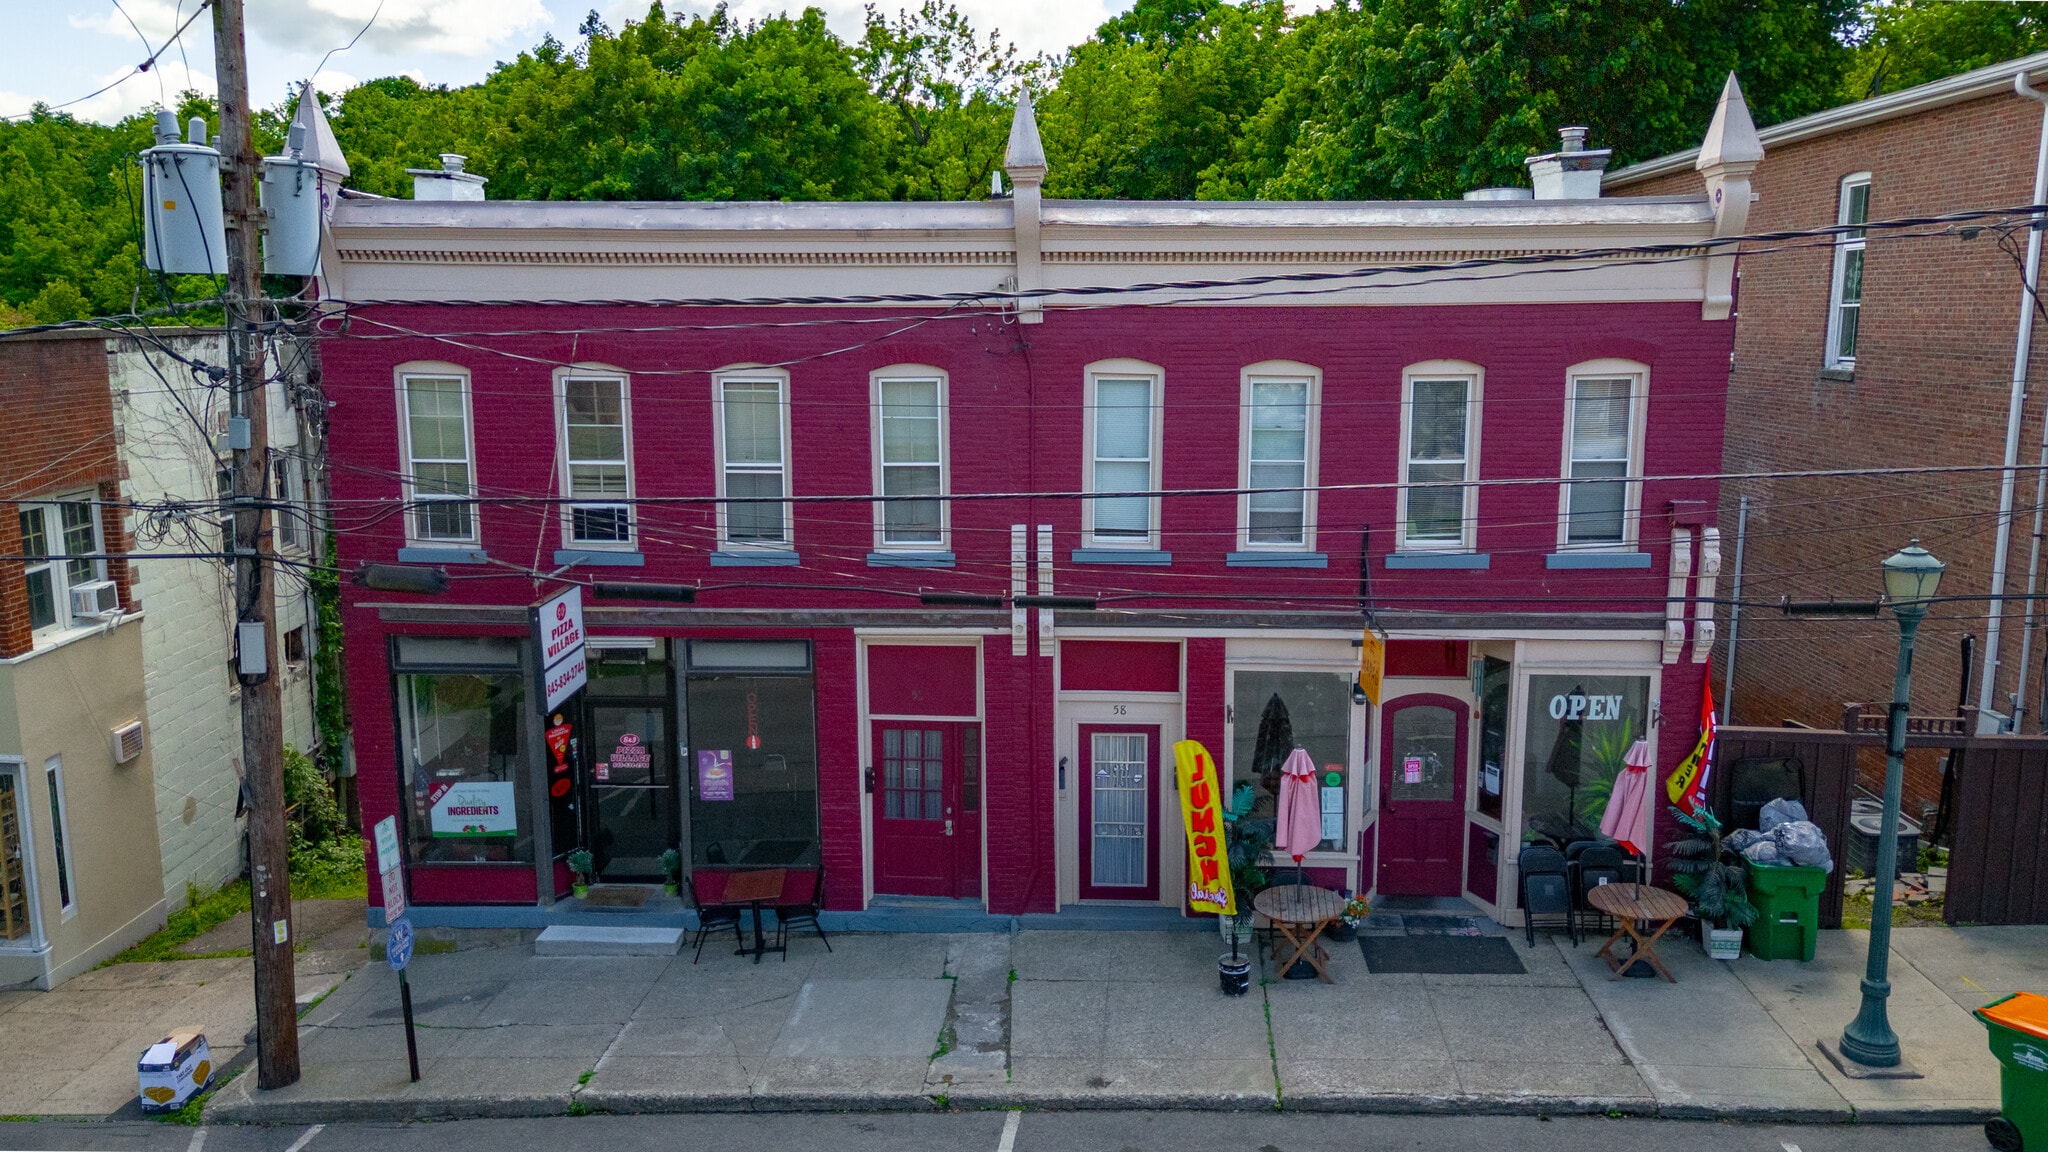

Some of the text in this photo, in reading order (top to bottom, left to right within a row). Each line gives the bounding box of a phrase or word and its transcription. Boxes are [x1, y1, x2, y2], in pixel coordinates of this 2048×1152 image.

[552, 618, 574, 641] PIZZA
[548, 629, 580, 658] VILLAGE
[547, 661, 585, 698] 845-834-2744
[1113, 704, 1127, 715] 58
[1549, 694, 1623, 720] OPEN
[610, 754, 651, 762] VILLAGE
[615, 746, 646, 754] PIZZA
[430, 788, 443, 803] STOP
[440, 783, 449, 792] IN
[447, 805, 499, 816] INGREDIENTS
[388, 882, 398, 895] NOT
[387, 893, 403, 910] BLOCK
